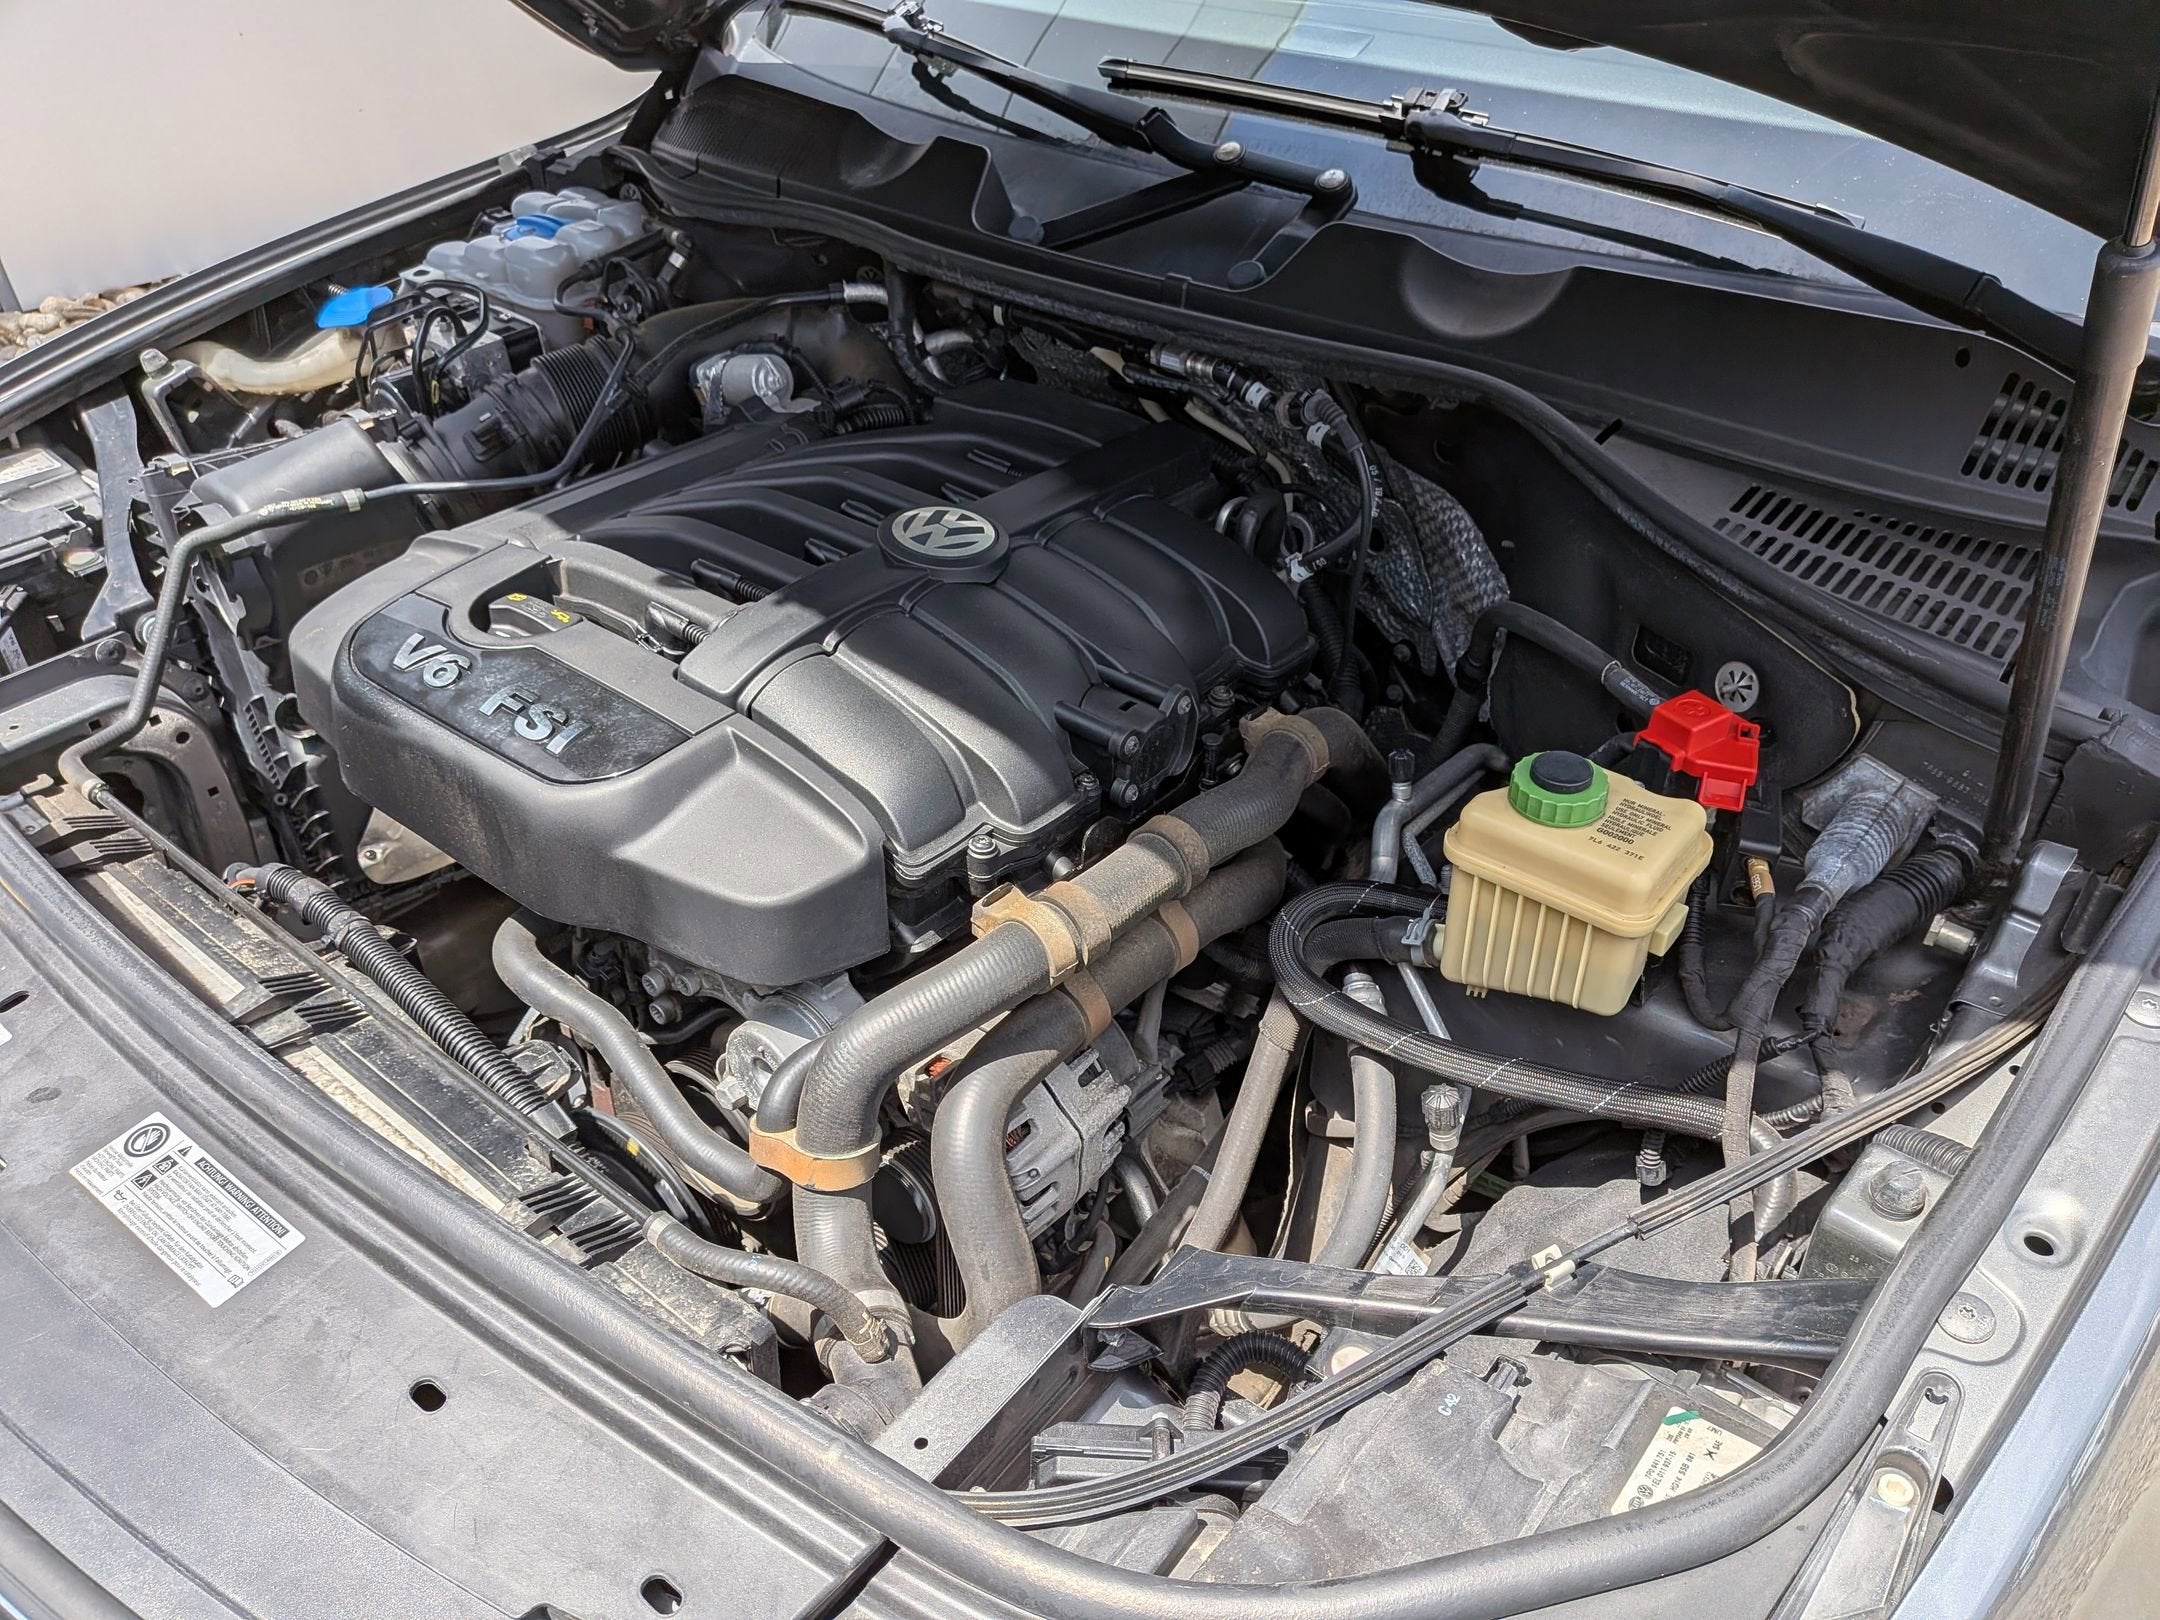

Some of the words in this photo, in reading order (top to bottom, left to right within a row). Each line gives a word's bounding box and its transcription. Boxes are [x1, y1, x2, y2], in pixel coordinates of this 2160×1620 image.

[393, 633, 472, 689] V6
[478, 685, 591, 755] FSI
[1601, 822, 1636, 838] SEULEMENT
[1611, 810, 1645, 826] HYDRAULIC
[1646, 822, 1664, 833] FLUID
[1627, 822, 1658, 837] MINERALE
[1629, 811, 1645, 820] ONLY
[1645, 817, 1672, 831] MINERAL
[196, 1159, 229, 1185] ACHTUNG!
[222, 1181, 256, 1209] WARNING!
[249, 1204, 287, 1236] ATTENTION!
